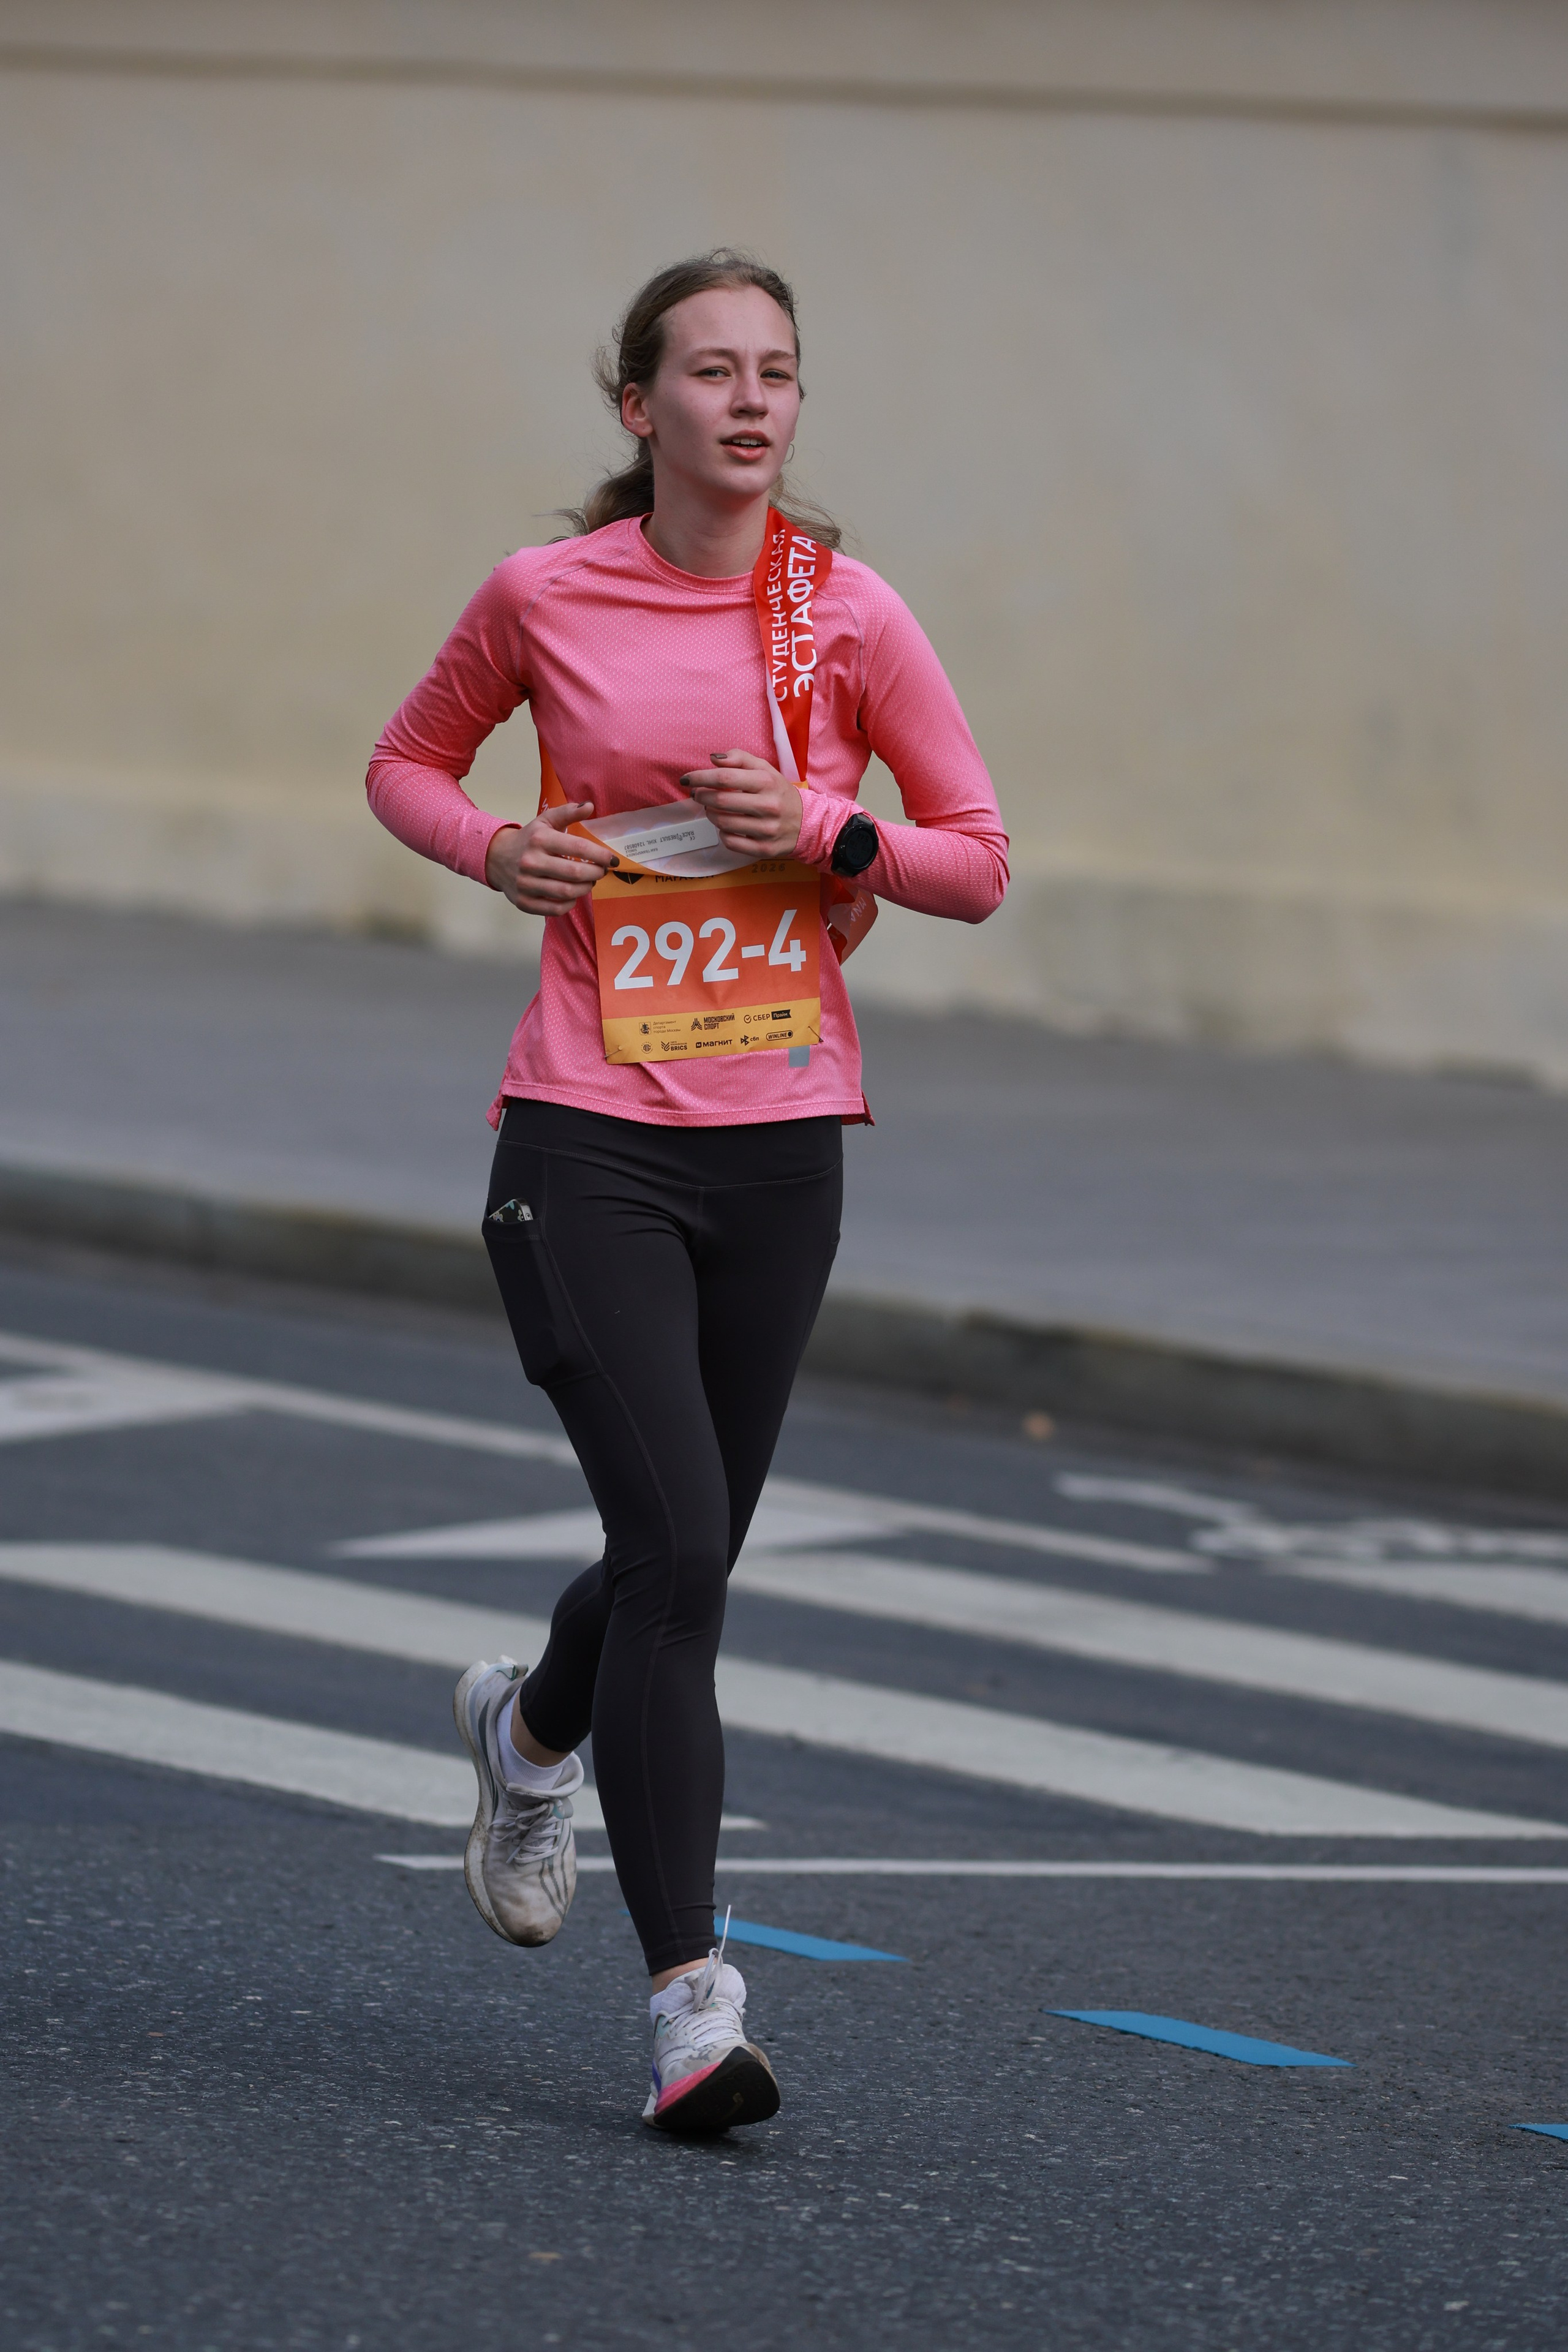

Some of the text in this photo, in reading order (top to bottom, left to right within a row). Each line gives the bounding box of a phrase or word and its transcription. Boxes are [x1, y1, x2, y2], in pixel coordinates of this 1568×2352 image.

[767, 529, 788, 702] СТУДЕНЧЕСКАЯ
[786, 535, 818, 698] ЭСТАФЕТА
[751, 863, 786, 873] 2026
[610, 908, 807, 990] 292-4
[703, 1012, 735, 1023] МОСКОВСКИЙ
